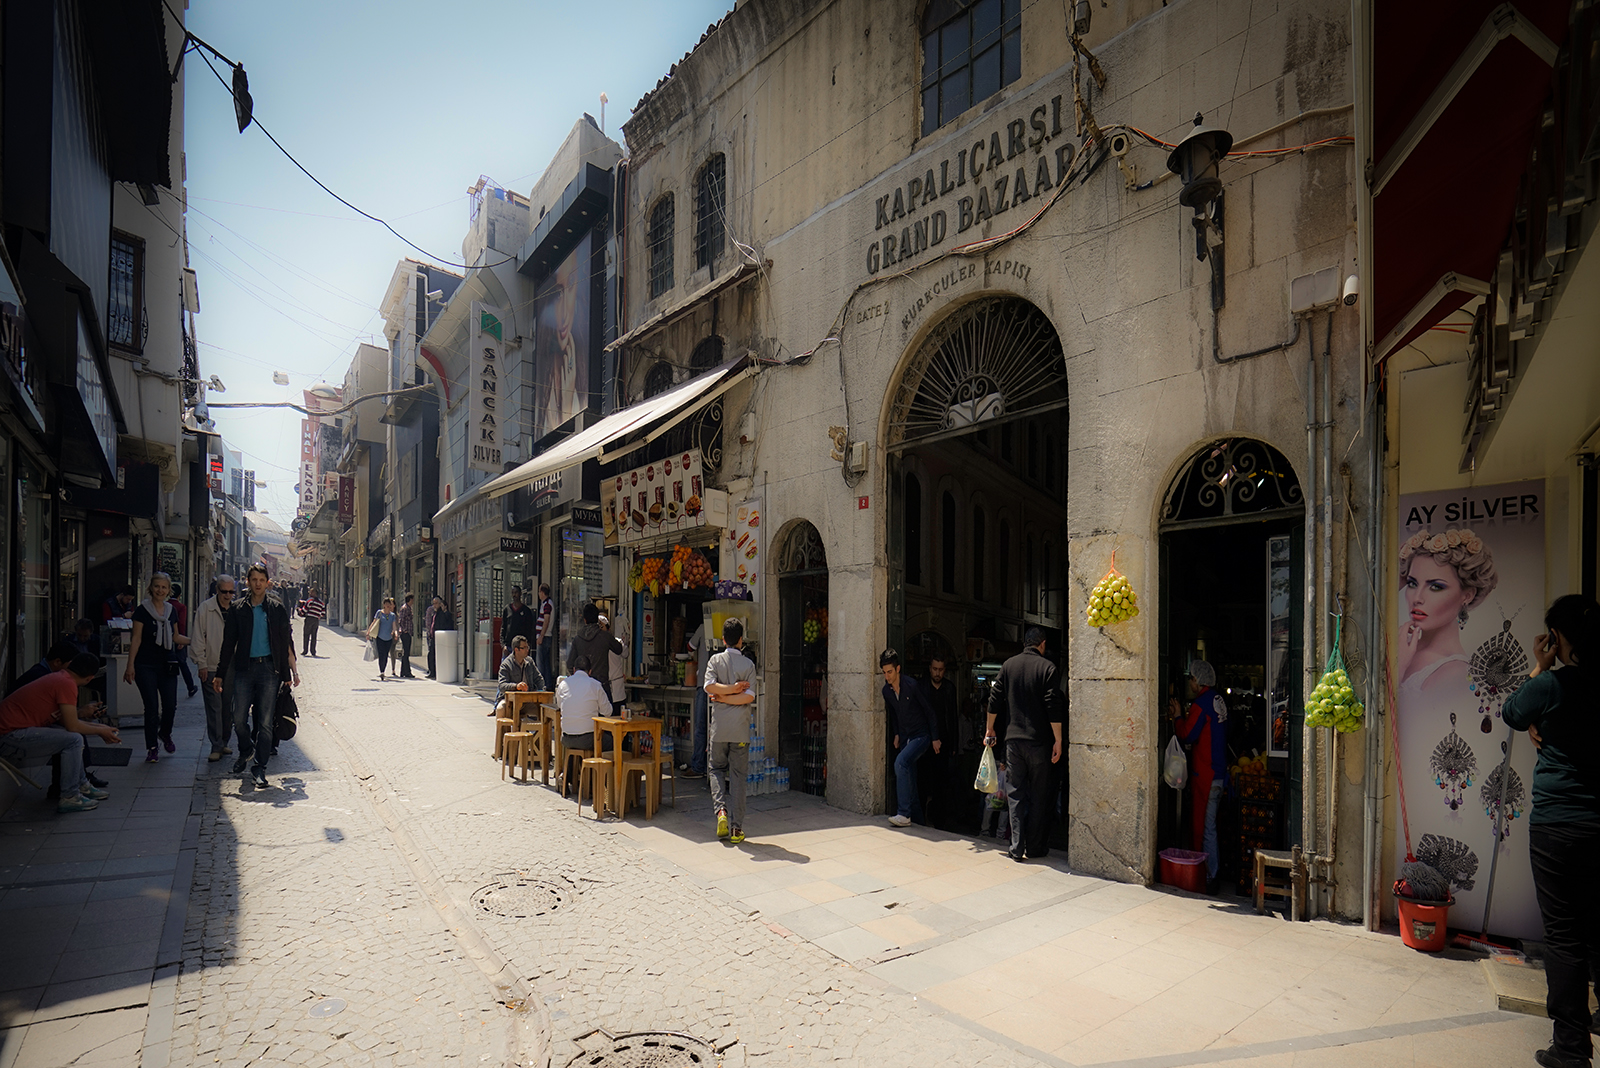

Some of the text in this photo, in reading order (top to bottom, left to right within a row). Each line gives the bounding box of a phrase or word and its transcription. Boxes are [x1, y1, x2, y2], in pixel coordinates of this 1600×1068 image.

[875, 94, 1062, 230] KAPALIÇARŞI
[866, 142, 1075, 275] GRAND BAZAAR
[984, 259, 1032, 282] KAPISI
[856, 300, 890, 324] GATE 2
[480, 346, 497, 443] SANCAK
[473, 444, 501, 466] SILVER
[304, 463, 314, 503] ENSAR
[536, 494, 551, 508] SILVER
[1405, 494, 1540, 526] AY SİLVER
